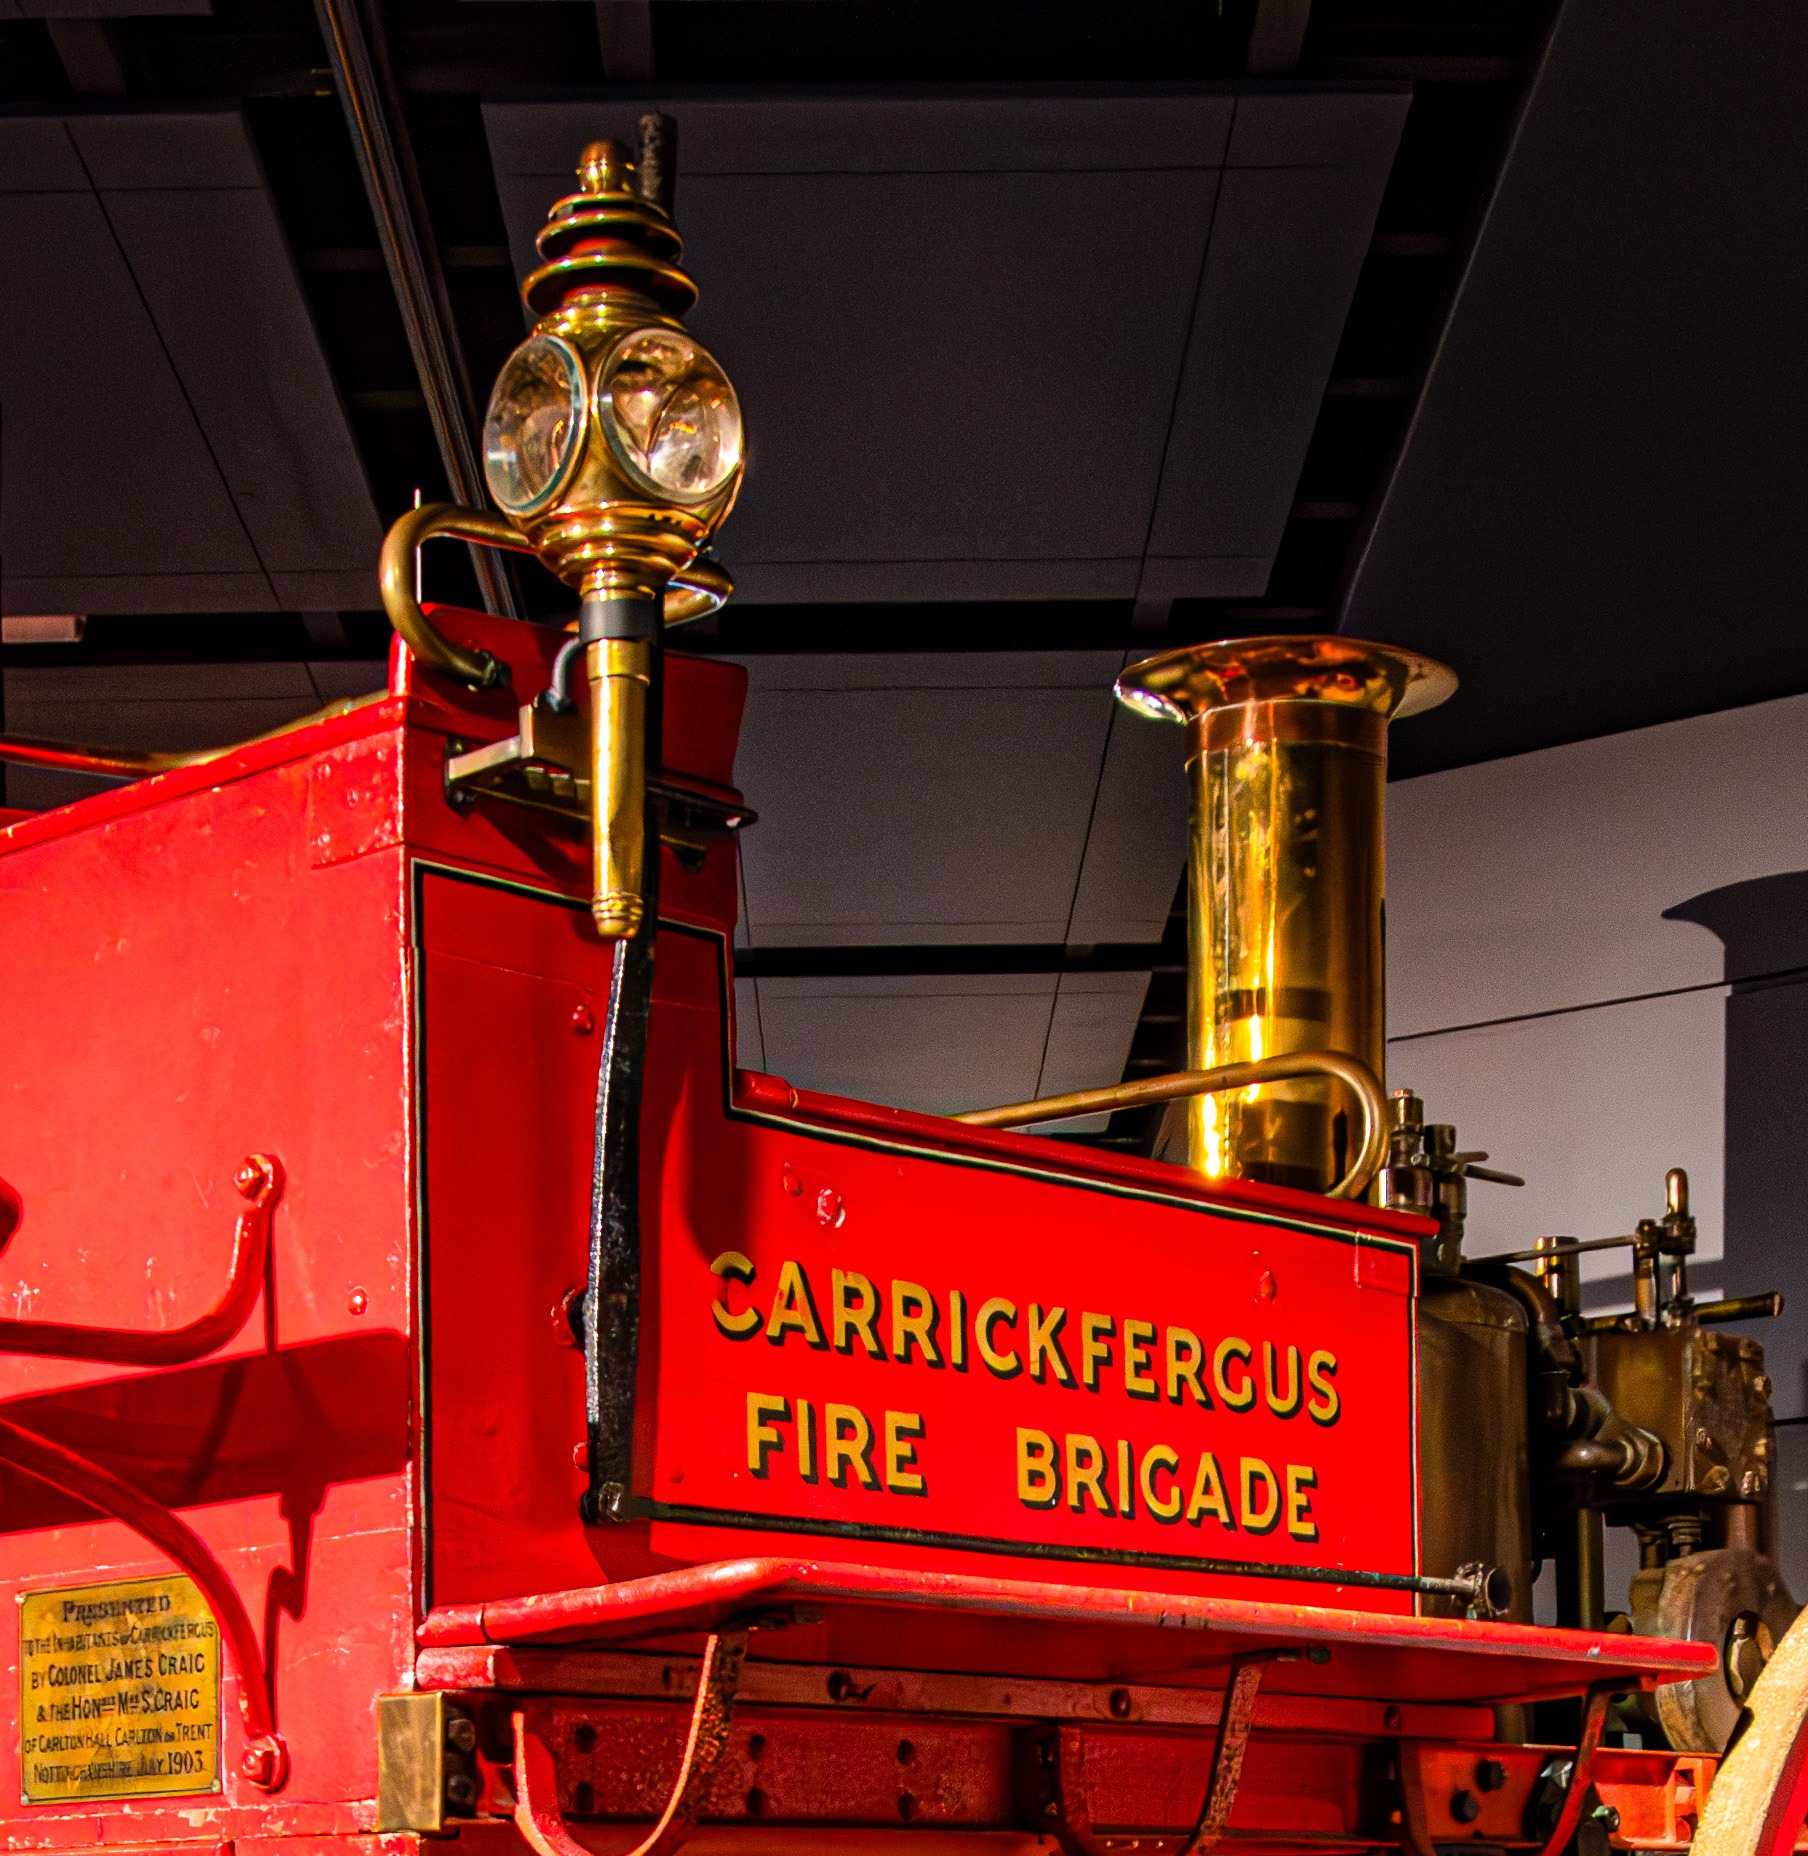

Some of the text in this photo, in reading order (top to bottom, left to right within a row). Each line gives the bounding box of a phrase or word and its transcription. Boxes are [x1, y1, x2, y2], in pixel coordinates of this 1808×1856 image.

[709, 1250, 1340, 1427] CARRICKFERGUS
[746, 1391, 1319, 1544] FIRE BRIGADE
[48, 1663, 101, 1687] COLONEL
[105, 1657, 154, 1682] JAMES
[158, 1653, 205, 1677] CRAIG
[49, 1703, 71, 1722] THE
[153, 1688, 200, 1712] CRAIG
[39, 1734, 83, 1753] CARLTON
[175, 1722, 214, 1743] TRENT
